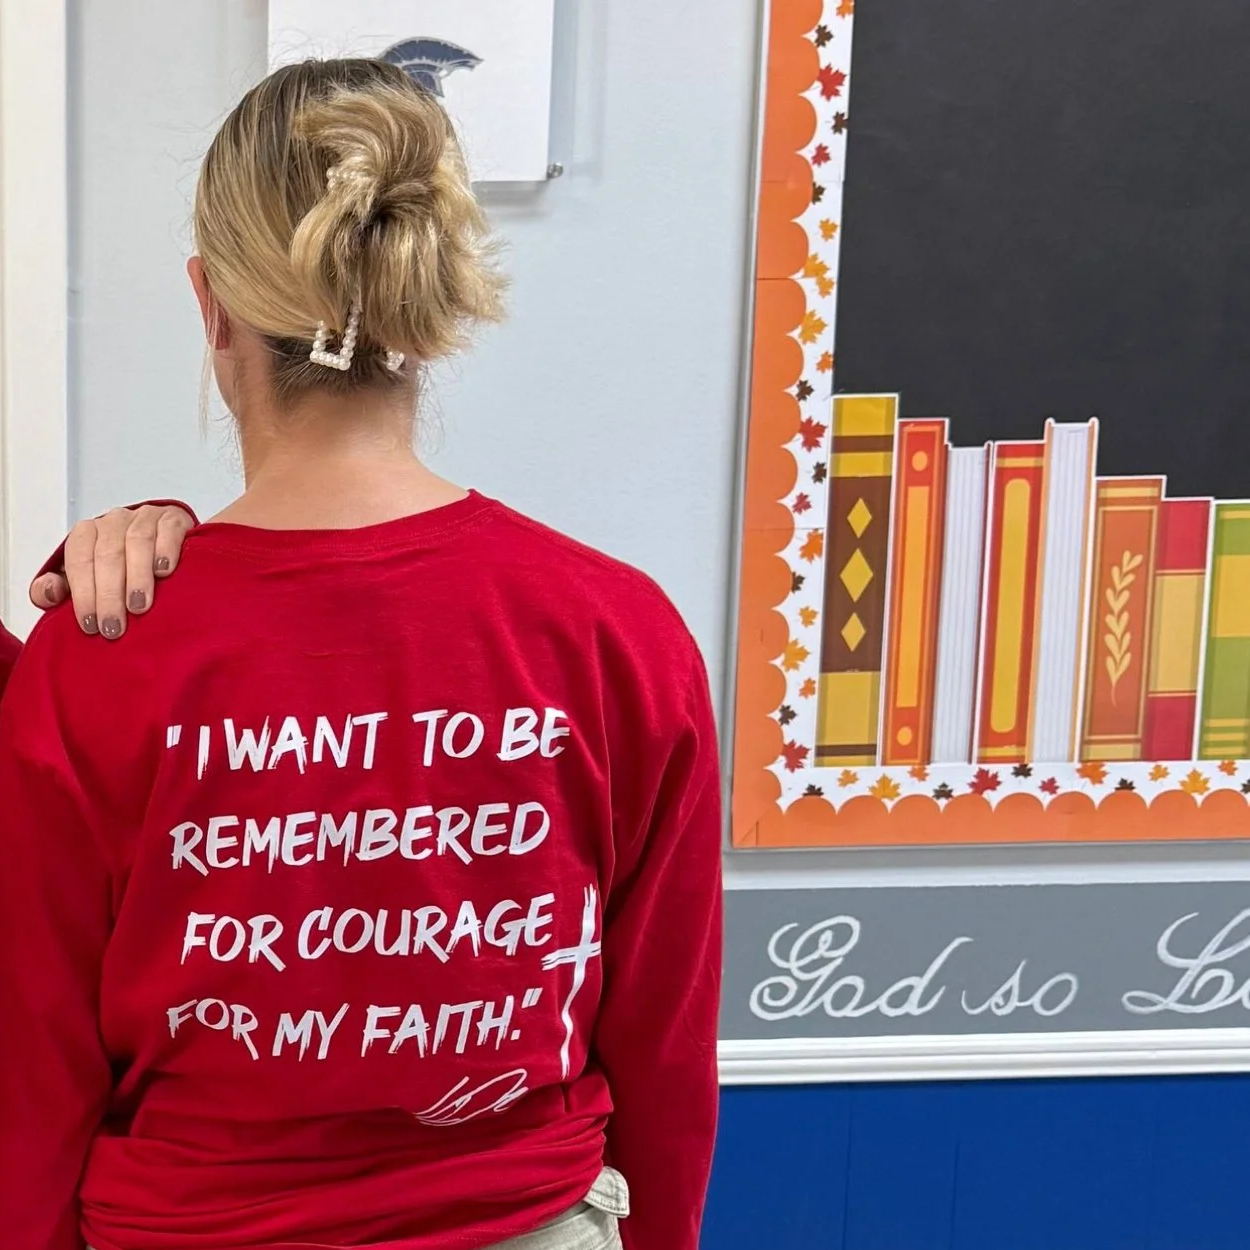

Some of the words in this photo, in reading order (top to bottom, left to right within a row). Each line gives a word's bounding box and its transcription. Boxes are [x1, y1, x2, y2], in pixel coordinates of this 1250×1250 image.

[224, 712, 388, 774] WANT
[413, 709, 485, 767] TO
[496, 707, 570, 761] BE
[169, 801, 550, 876] REMEMBERED
[181, 912, 286, 972] FOR
[297, 893, 555, 963] COURAGE
[749, 915, 975, 1021] God
[961, 959, 1079, 1016] so
[166, 998, 259, 1060] FOR
[272, 1003, 350, 1061] MY
